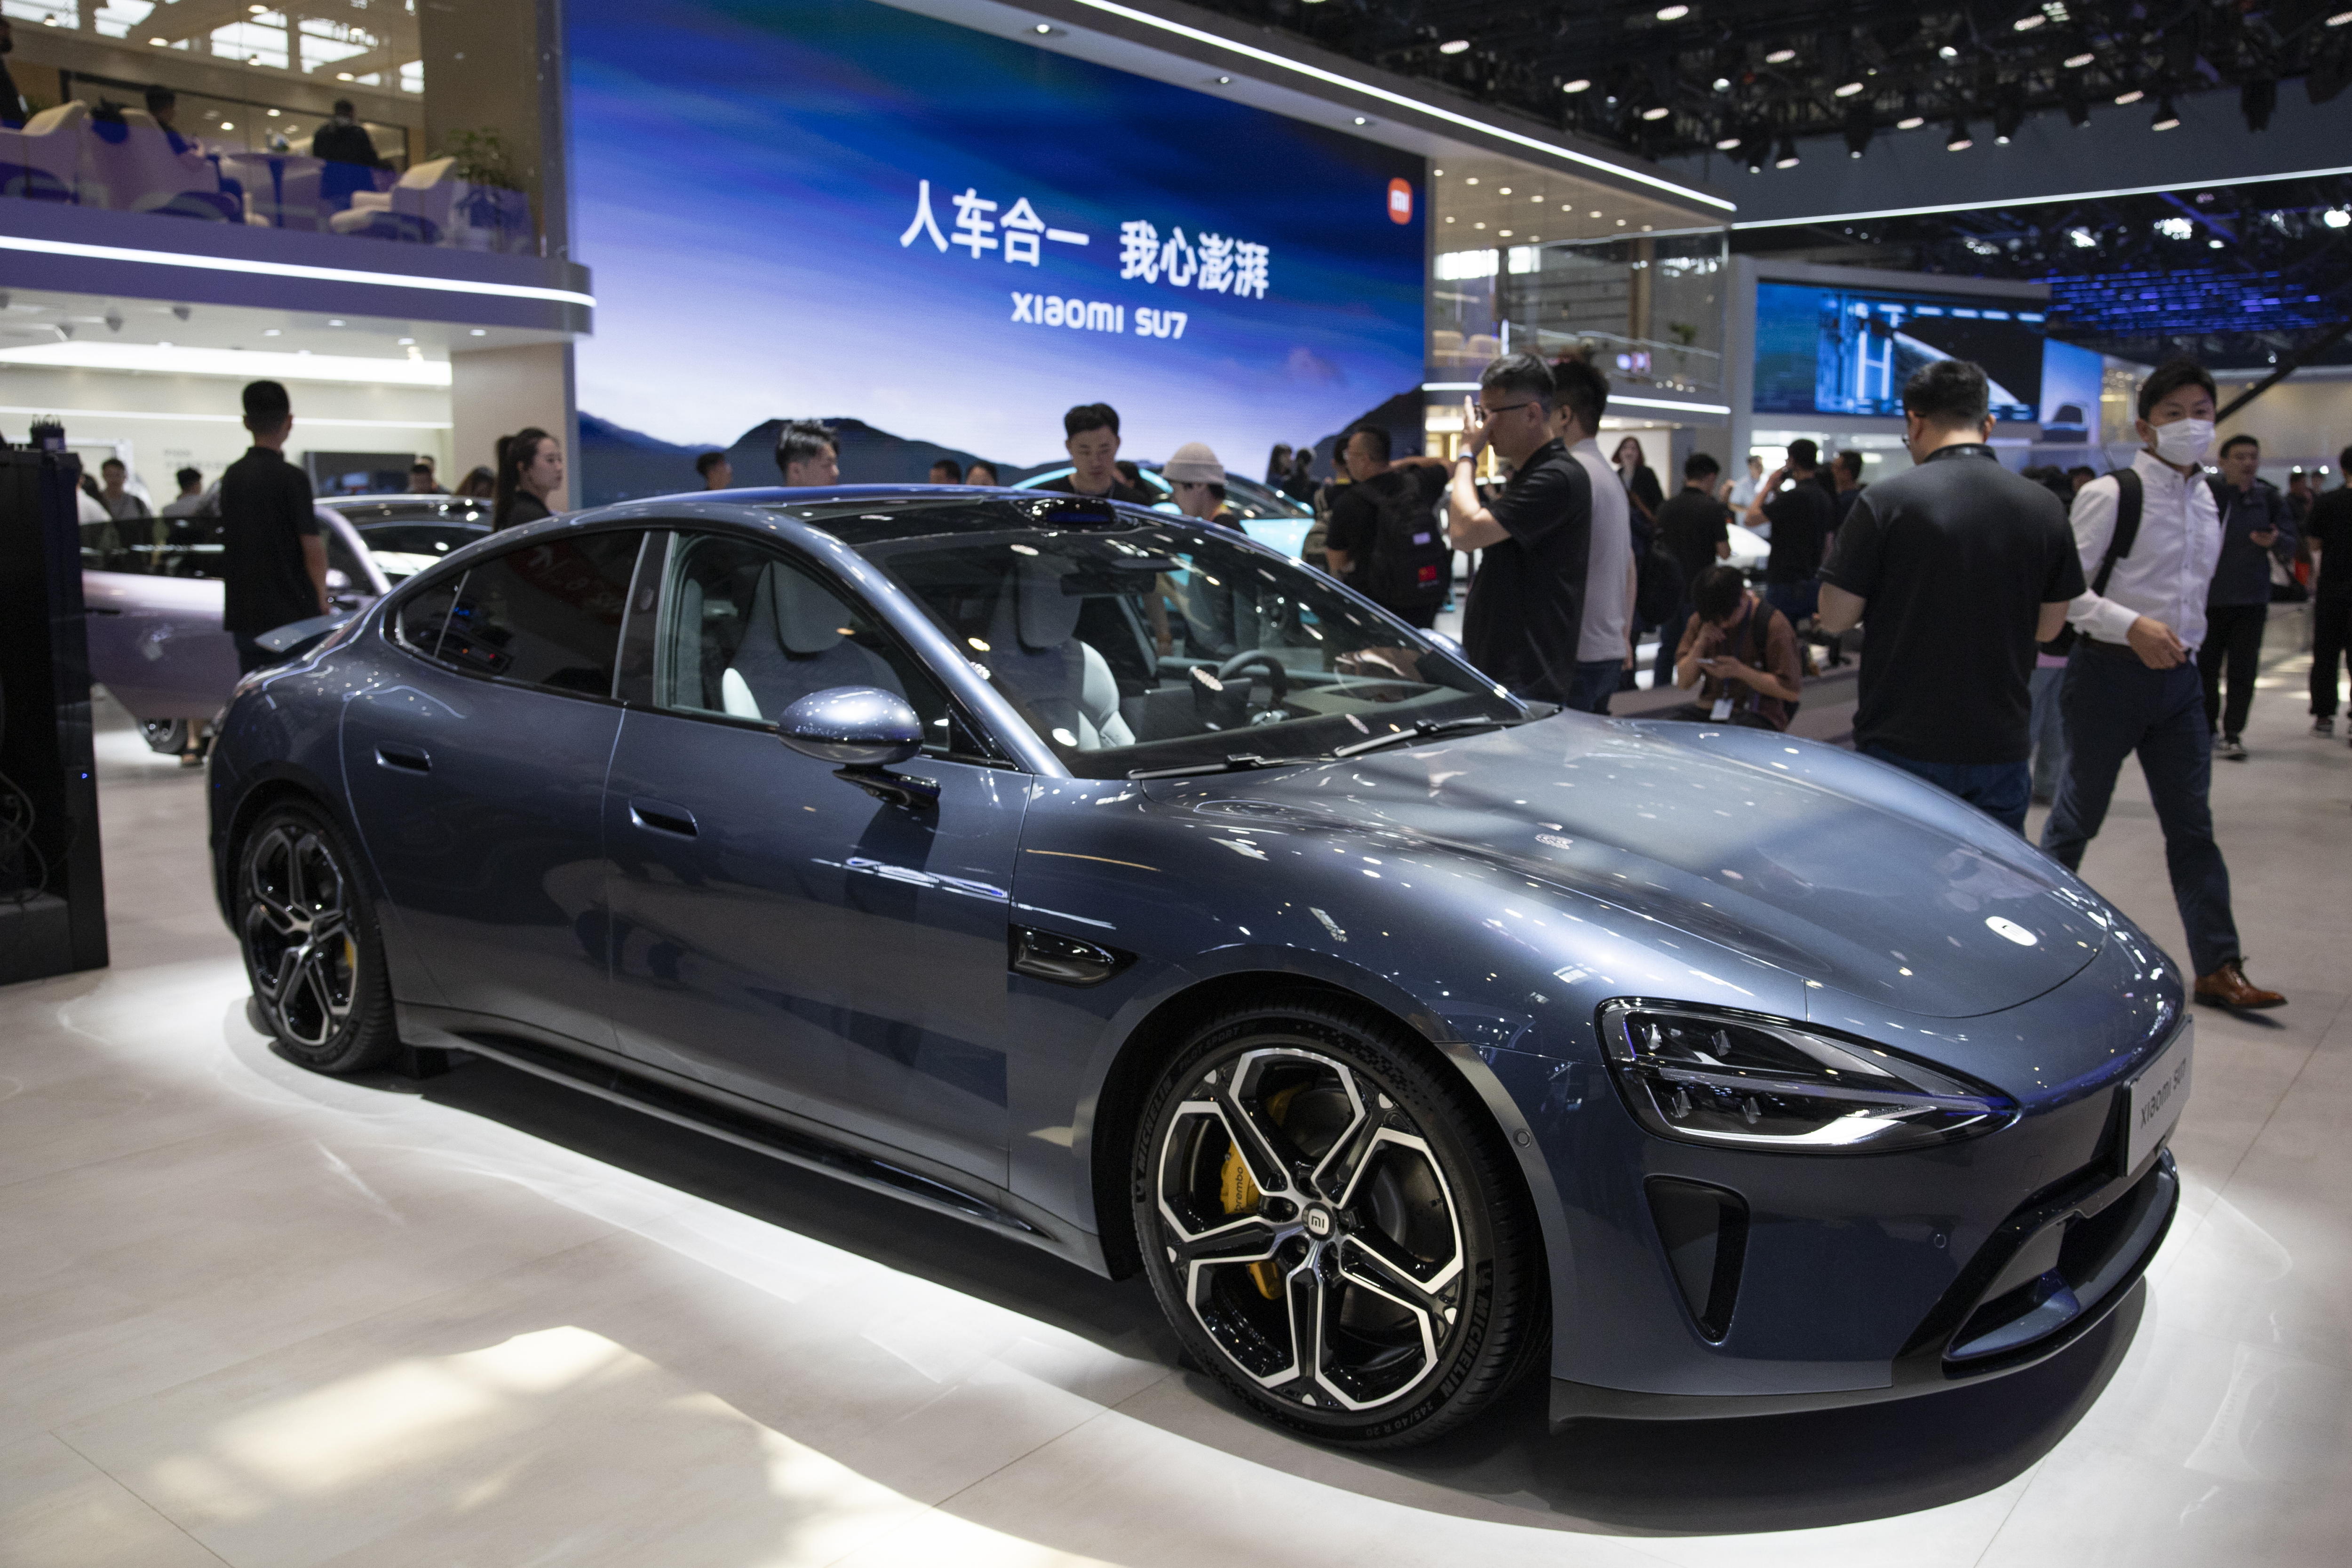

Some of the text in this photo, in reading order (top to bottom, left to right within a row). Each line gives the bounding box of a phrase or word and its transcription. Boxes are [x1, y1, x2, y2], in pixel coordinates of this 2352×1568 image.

[899, 179, 1270, 300] 人车合一 我心澎湃
[1206, 1026, 1240, 1049] SPORT
[1137, 1075, 1173, 1174] MICHELIN
[1234, 1166, 1244, 1211] brembo
[1439, 1294, 1490, 1398] MICHELIN
[1366, 1400, 1434, 1437] 245/40 R 20
